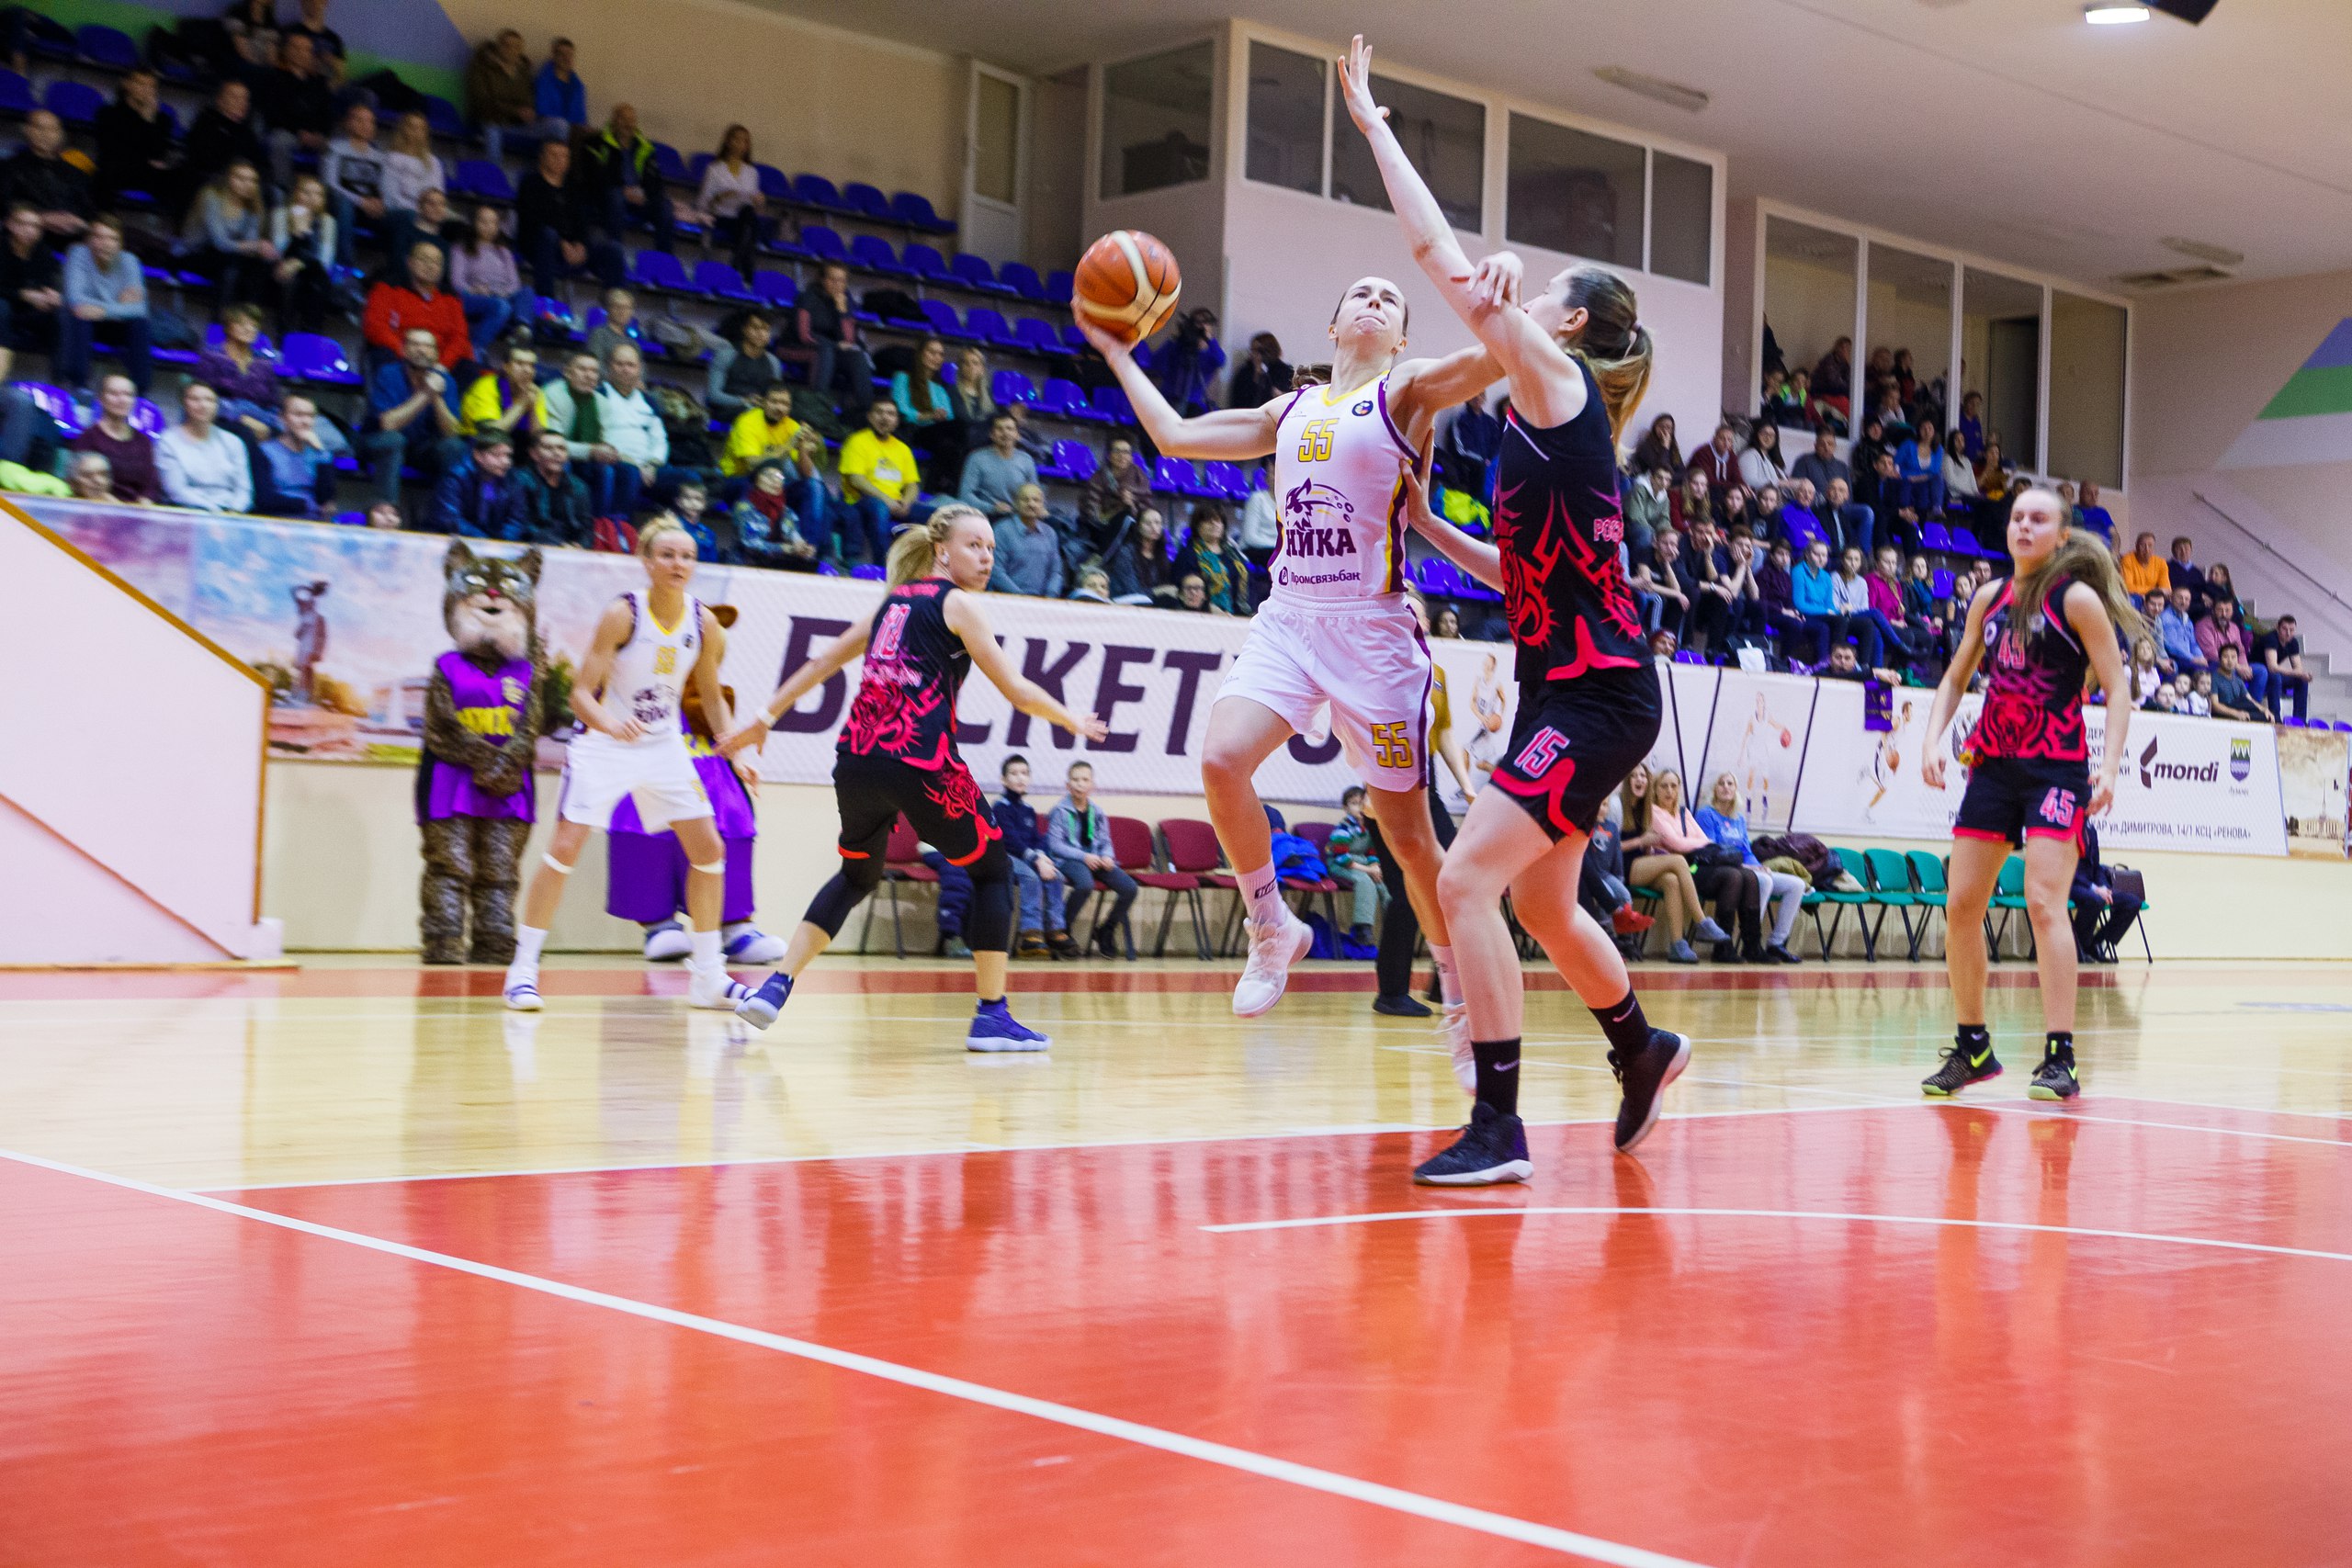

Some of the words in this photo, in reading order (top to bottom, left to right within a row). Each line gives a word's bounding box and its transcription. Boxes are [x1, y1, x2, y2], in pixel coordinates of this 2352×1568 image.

[1298, 418, 1340, 462] 55
[1286, 527, 1356, 558] НИКА
[1370, 720, 1413, 769] 55
[1514, 726, 1570, 778] 15
[2154, 761, 2219, 783] mondi
[2040, 786, 2076, 828] 45
[2195, 824, 2211, 840] КСЦ
